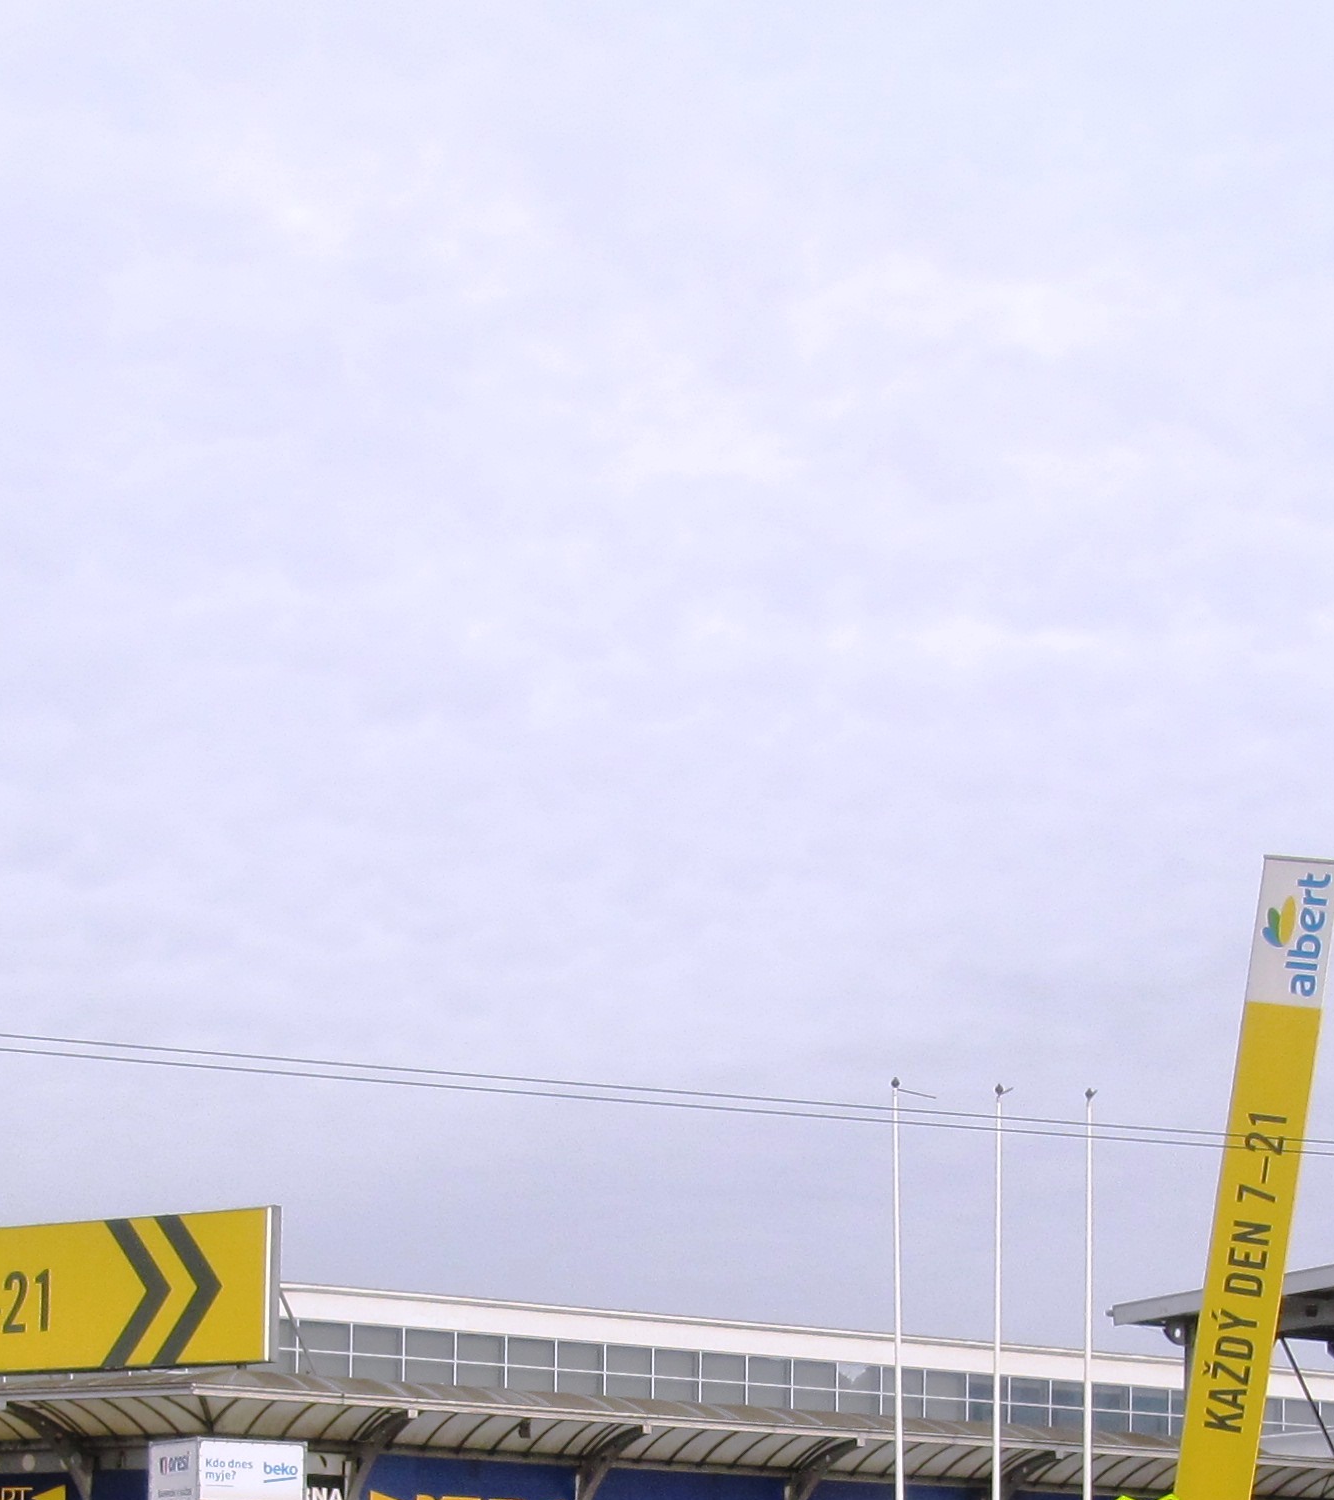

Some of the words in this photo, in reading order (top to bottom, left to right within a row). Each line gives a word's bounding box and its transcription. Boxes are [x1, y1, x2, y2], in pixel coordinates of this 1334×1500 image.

[1284, 872, 1332, 998] albert
[1224, 1220, 1271, 1297] DEN
[1203, 1308, 1258, 1434] KAŽDÝ
[205, 1458, 226, 1468] Kdo
[228, 1459, 253, 1469] dnes
[205, 1469, 236, 1481] myje?
[263, 1462, 298, 1475] beko
